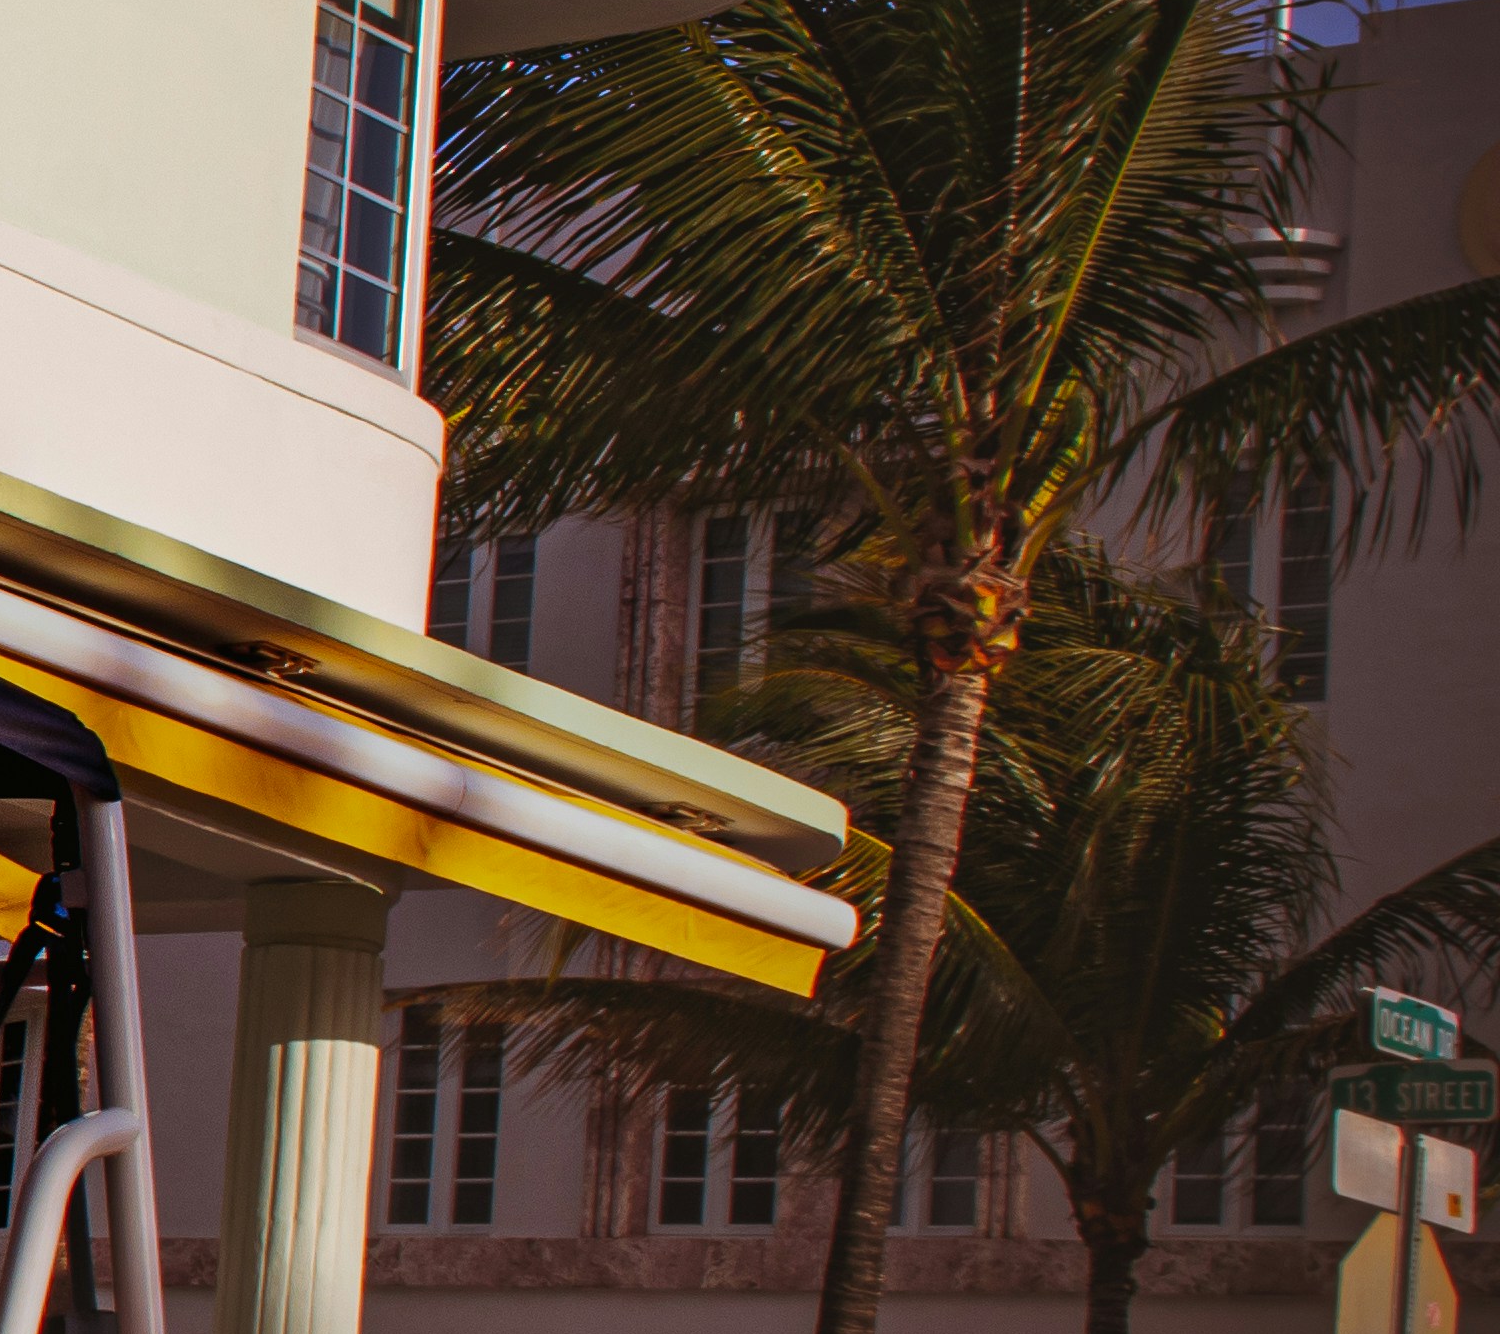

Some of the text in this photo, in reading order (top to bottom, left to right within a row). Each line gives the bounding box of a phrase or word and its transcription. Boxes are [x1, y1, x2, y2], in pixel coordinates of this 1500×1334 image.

[1380, 1007, 1434, 1052] OCEAN
[1348, 1079, 1489, 1117] 13 STREET
